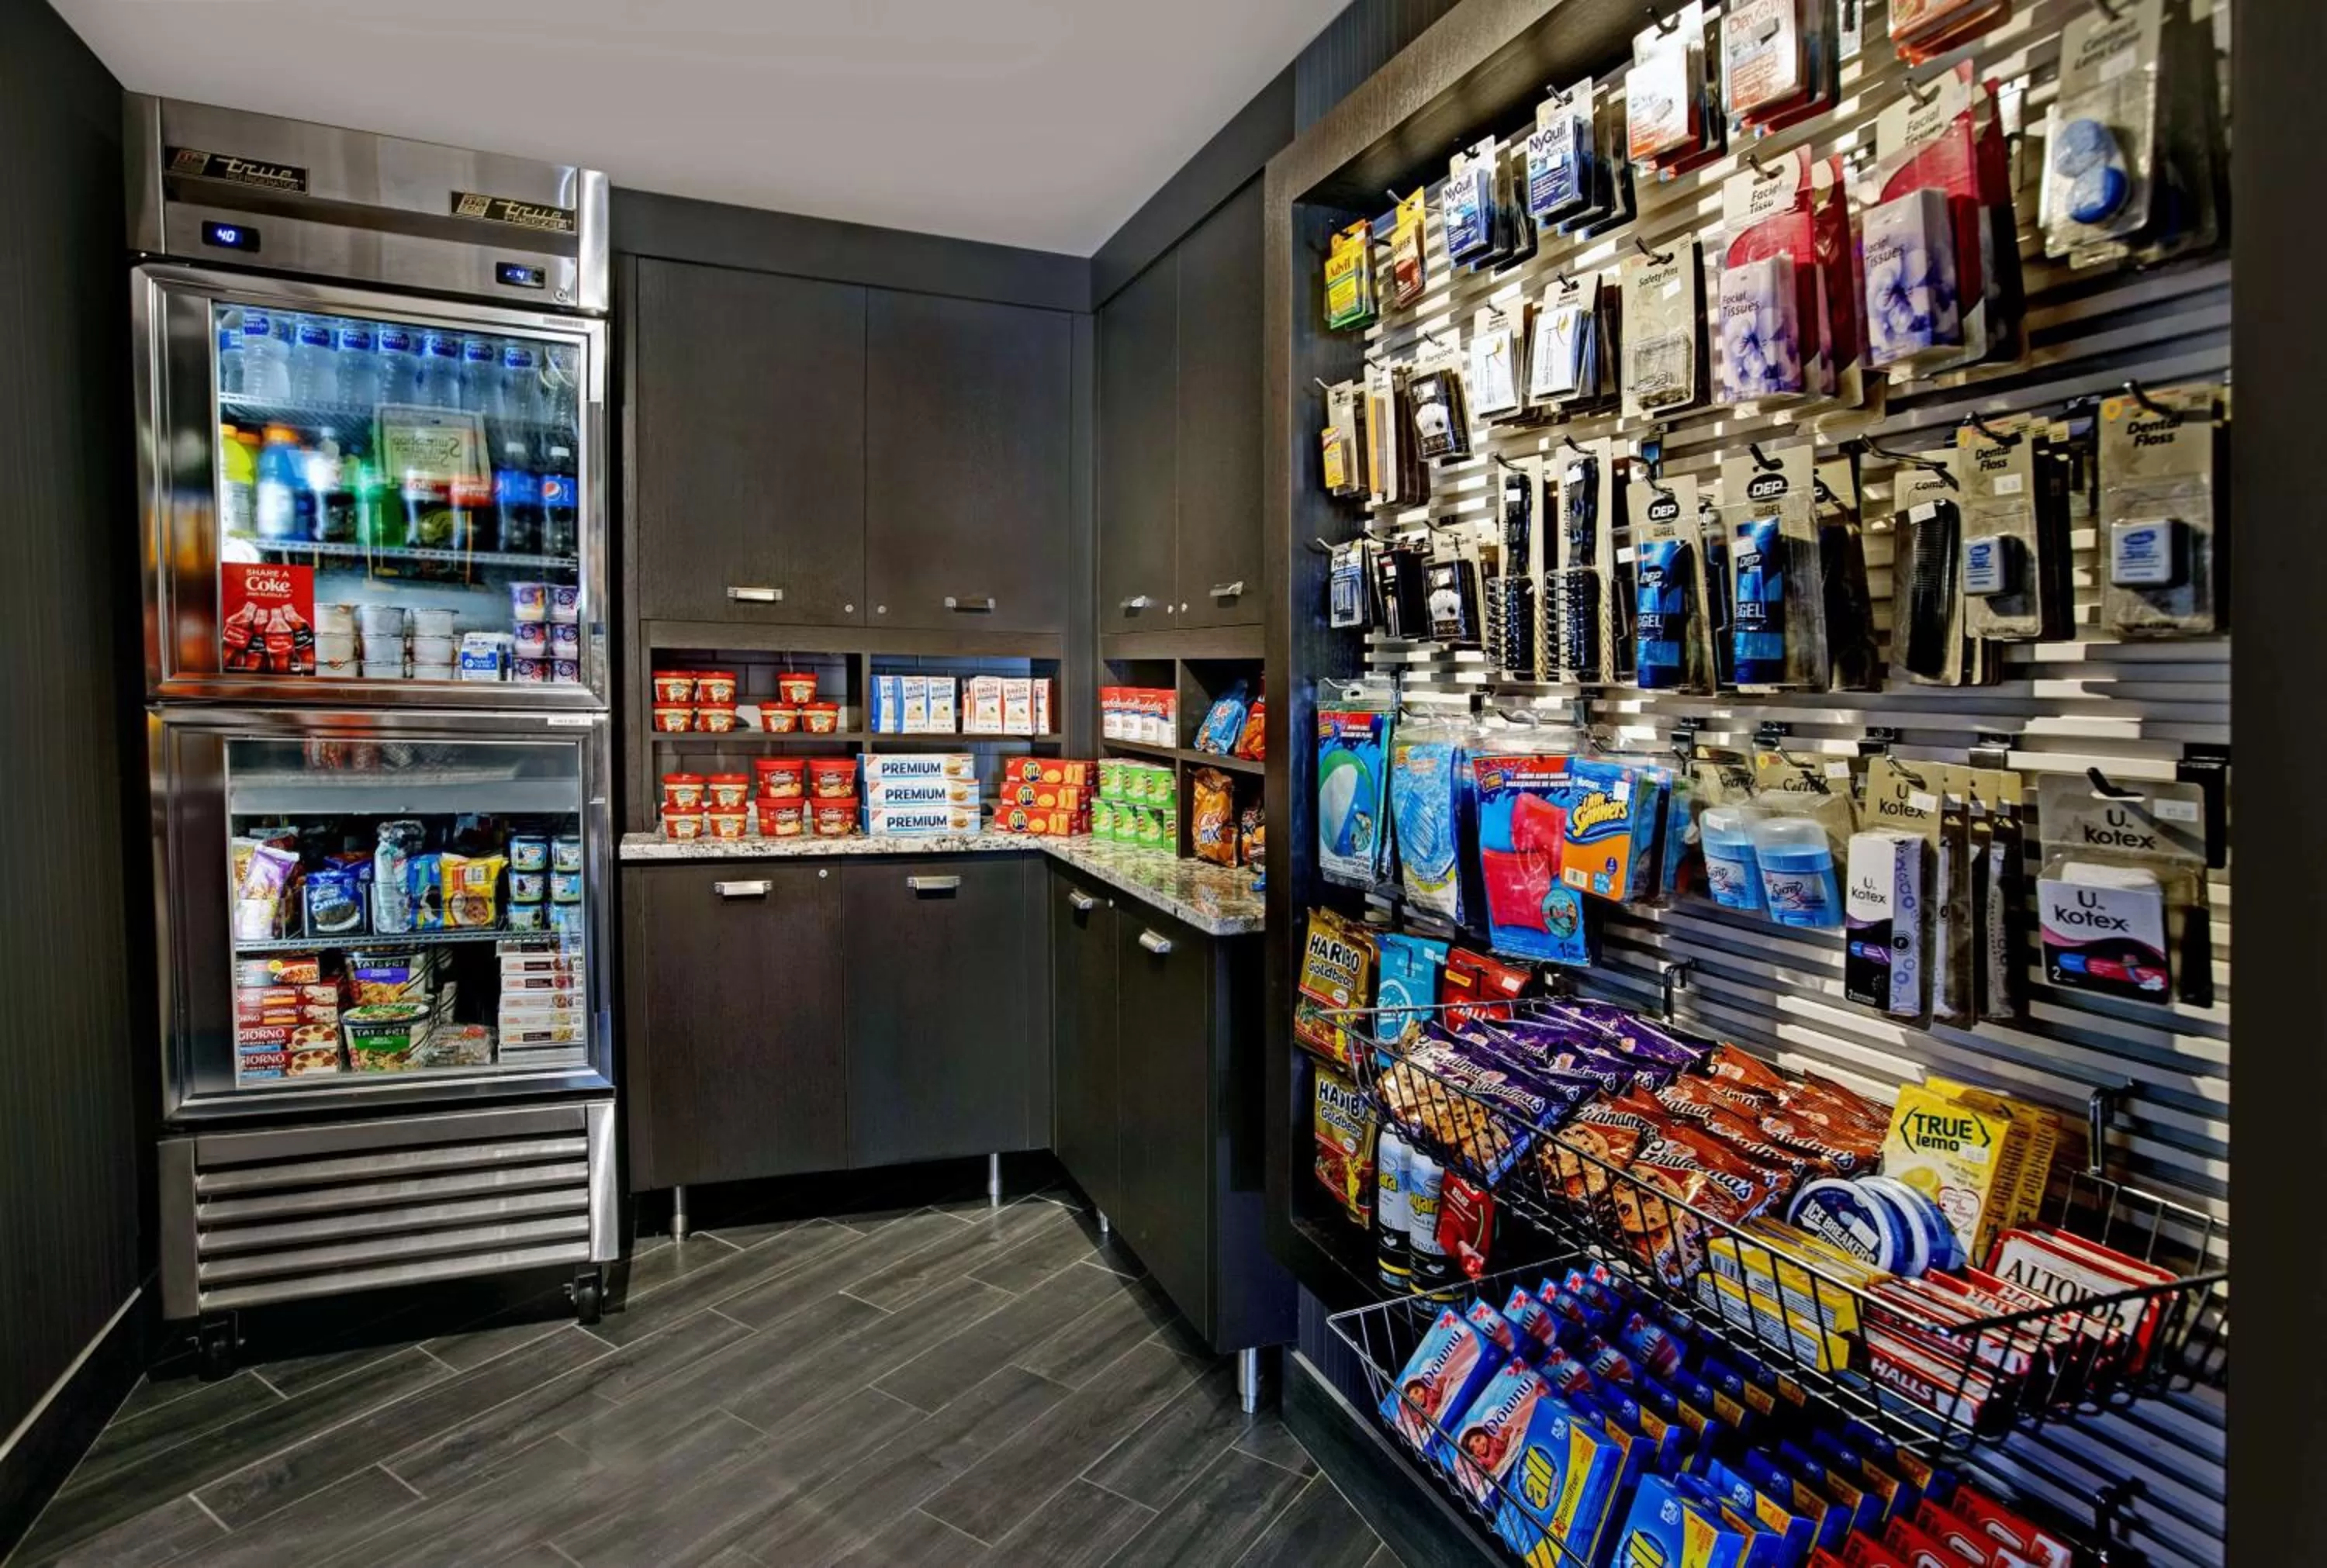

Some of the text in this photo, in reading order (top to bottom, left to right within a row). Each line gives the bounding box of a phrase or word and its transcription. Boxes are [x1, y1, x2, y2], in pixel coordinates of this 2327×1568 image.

[1530, 119, 1567, 153] NyQuil
[1444, 173, 1473, 203] NyQuil
[217, 229, 236, 243] 40
[1637, 272, 1663, 289] Safety
[1722, 299, 1761, 319] Tissues
[2126, 413, 2185, 435] Dental
[2134, 431, 2177, 448] Floss
[1975, 444, 2012, 461] Dental
[1980, 458, 2008, 472] Floss
[1751, 478, 1784, 497] DEP
[1651, 503, 1677, 520] DEP
[1764, 503, 1784, 517] GEL
[244, 576, 292, 592] Coke
[1640, 570, 1663, 584] DEP
[881, 762, 942, 775] PREMIUM
[884, 788, 946, 801] PREMIUM
[1879, 796, 1927, 820] kotex
[2106, 808, 2127, 828] U
[887, 814, 948, 828] PREMIUM
[2083, 824, 2157, 851] kotex
[1863, 876, 1874, 890] U
[1851, 886, 1887, 906] kotex
[2076, 890, 2097, 910] U
[2053, 905, 2130, 932] kotex
[1309, 934, 1361, 973] HARIBO
[2051, 965, 2061, 981] 2
[1913, 1113, 1973, 1140] TRUE
[1915, 1132, 1960, 1152] lemo
[1802, 1198, 1827, 1225] ICE
[1822, 1215, 1877, 1266] BREAKERS
[1422, 1328, 1464, 1390] Downy
[1869, 1358, 1935, 1402] HALLS
[1482, 1376, 1536, 1438] Downy
[1525, 1443, 1554, 1511] all
